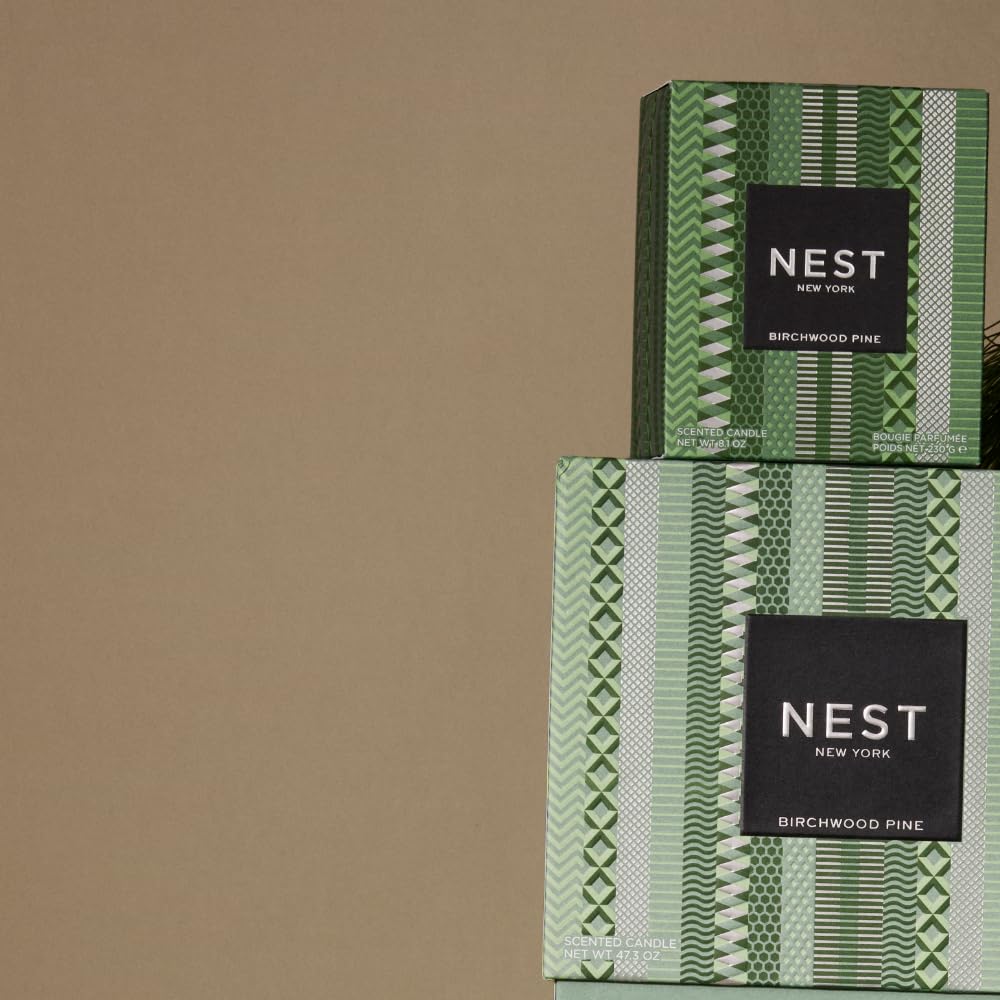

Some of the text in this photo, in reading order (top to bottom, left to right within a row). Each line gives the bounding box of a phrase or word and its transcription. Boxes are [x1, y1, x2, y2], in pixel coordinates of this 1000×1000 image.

[769, 248, 885, 280] NEST
[797, 283, 856, 294] NEW YORK
[768, 332, 882, 344] BIRCHWOOD PINE
[677, 427, 768, 438] SCENTED CANDLE
[873, 433, 968, 443] BOUGIE PARFUMÉE
[677, 439, 747, 448] NET WT 8.1 OZ
[873, 443, 903, 452] POIDS
[905, 444, 925, 453] NET
[927, 445, 946, 453] 230
[948, 446, 956, 454] G
[782, 701, 927, 741] NEST
[815, 747, 891, 759] NEW YORK
[778, 816, 924, 831] BIRCHWOOD PINE
[564, 936, 677, 949] SCENTED CANDLE
[564, 949, 661, 961] NET WT 47.3 OZ
